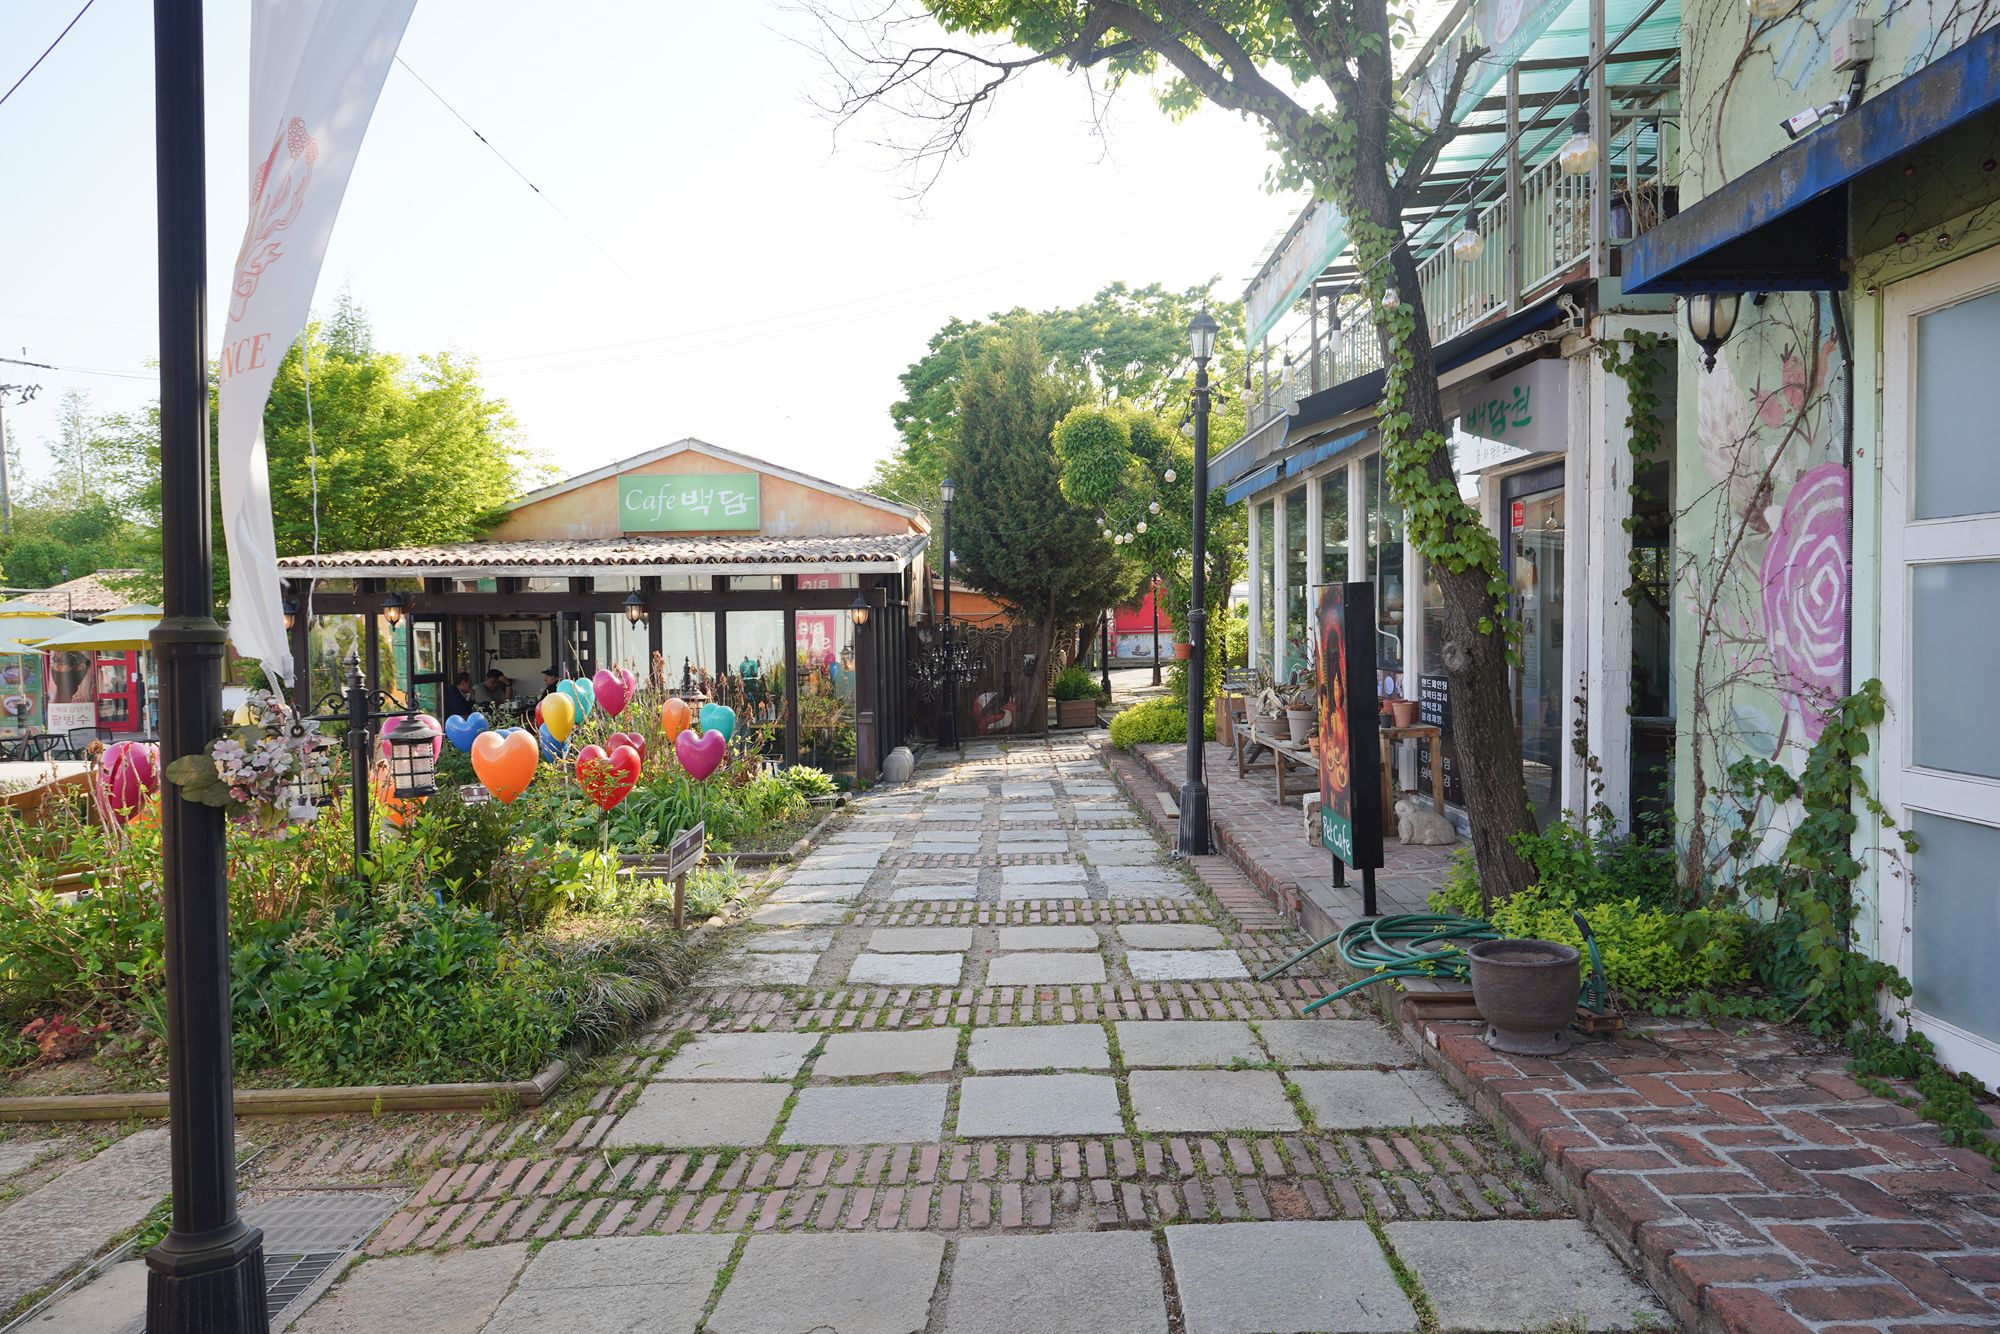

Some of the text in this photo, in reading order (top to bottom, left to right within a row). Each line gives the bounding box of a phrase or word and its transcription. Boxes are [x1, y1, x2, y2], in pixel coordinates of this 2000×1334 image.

[223, 332, 272, 378] NCE
[1466, 385, 1533, 444] 백담원
[625, 483, 755, 521] Cafe 백담
[51, 714, 90, 726] 팥빙수
